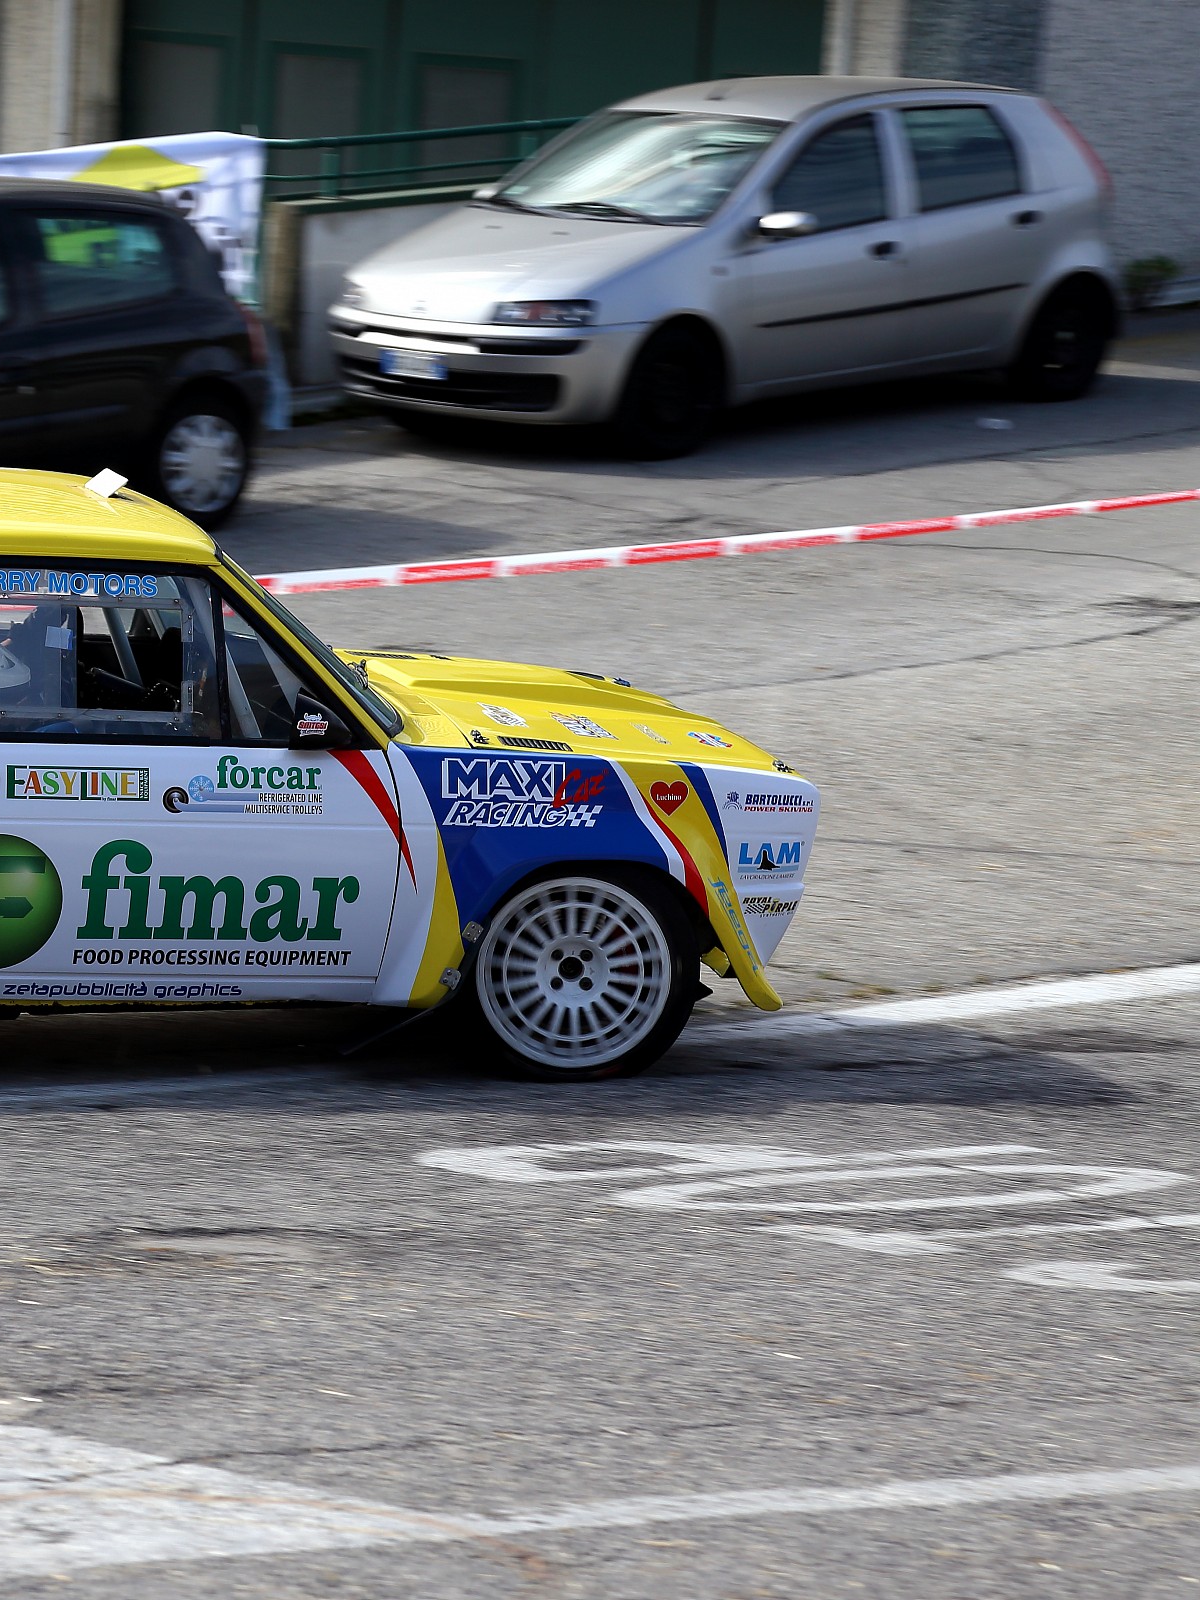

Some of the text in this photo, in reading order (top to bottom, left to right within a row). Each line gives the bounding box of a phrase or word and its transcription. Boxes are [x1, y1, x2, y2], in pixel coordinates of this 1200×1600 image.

[48, 572, 158, 597] MOTORS
[217, 755, 322, 789] forcar
[442, 758, 566, 800] MAXI
[260, 793, 322, 803] REFRIGERATED LINE
[656, 793, 682, 801] Luchino
[745, 794, 802, 806] BARTOLUCCI
[245, 804, 322, 814] MULTISERVICE TROLLEYS
[442, 801, 569, 828] RACING
[738, 842, 800, 865] LAM
[76, 839, 360, 942] fimar
[72, 949, 351, 967] FOOD PROCESSING EQUIPMENT
[3, 981, 243, 999] zetapubblicità graphics
